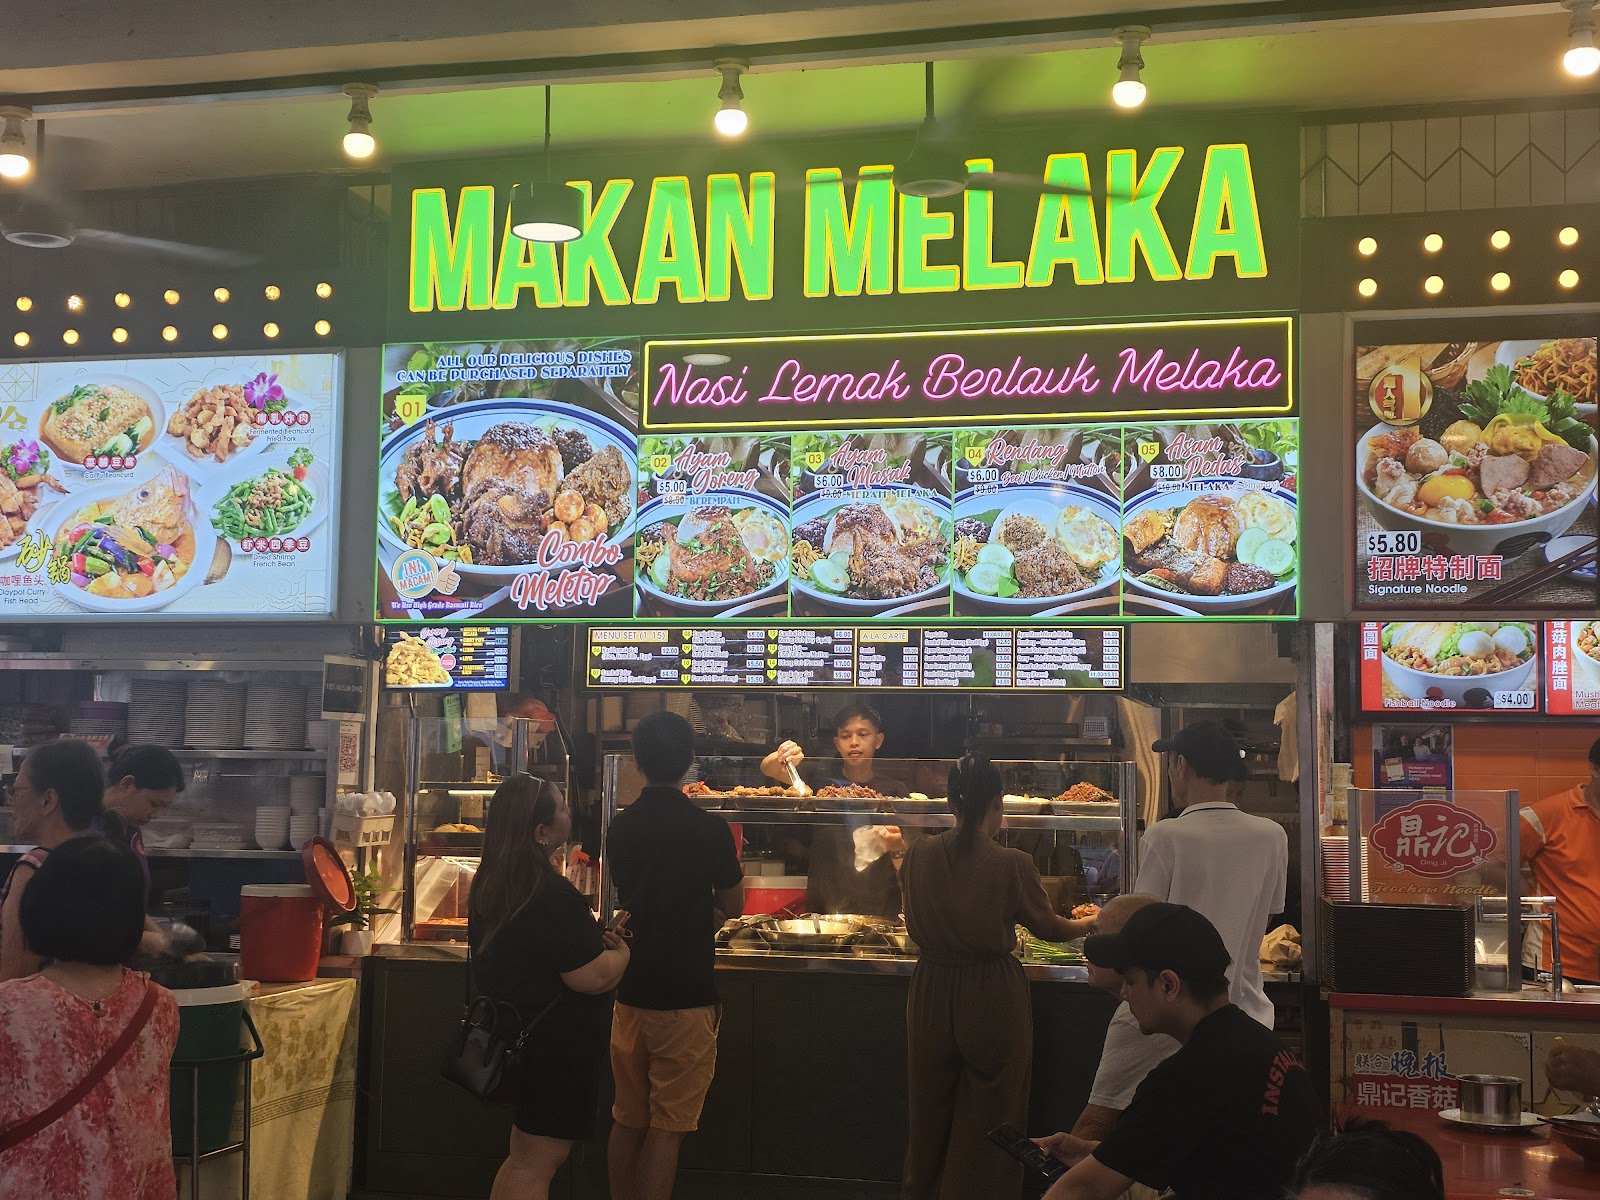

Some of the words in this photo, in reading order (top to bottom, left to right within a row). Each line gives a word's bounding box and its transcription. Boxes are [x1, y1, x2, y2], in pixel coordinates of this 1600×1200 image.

[409, 171, 776, 313] MAKAN
[803, 143, 1269, 298] MELAKA
[437, 355, 463, 368] ALL
[467, 354, 499, 367] OUR
[500, 352, 574, 366] DELICIOUS
[577, 350, 632, 364] DISHES
[396, 370, 426, 382] CAN
[428, 370, 447, 382] BE
[450, 367, 537, 382] PURCHASED
[540, 364, 631, 379] SEPARATELY
[651, 363, 748, 407] Nasi
[758, 358, 911, 404] Lemak
[922, 351, 1100, 400] Berlauk
[1112, 345, 1283, 394] Melaka
[401, 401, 421, 418] 01
[967, 448, 982, 460] 04
[986, 437, 1068, 466] Rendang
[1140, 444, 1156, 455] 05
[1164, 433, 1223, 462] Asam
[653, 456, 667, 468] 02
[673, 443, 732, 474] Ayam
[808, 453, 822, 465] 03
[830, 440, 886, 471] Ayam
[847, 458, 912, 491] Masak
[1152, 465, 1181, 478] $8.00
[1184, 452, 1245, 482] Pedas
[691, 467, 760, 495] Goreng
[816, 475, 842, 487] $6.00
[970, 469, 997, 481] $6.00
[658, 481, 685, 493] $5.00
[846, 490, 888, 499] MERAH
[889, 488, 938, 498] MELAKA
[1185, 482, 1230, 492] MELAKA
[689, 495, 741, 505] BEREMPAH
[538, 530, 623, 569] Combo
[1368, 532, 1418, 553] $5.80
[272, 553, 296, 561] Shrimp
[403, 559, 422, 575] INI
[1367, 555, 1503, 581] 招牌特制面
[399, 572, 435, 591] MACAM!
[511, 568, 616, 610] Meletop
[26, 588, 46, 597] Curry
[1368, 584, 1422, 595] Signature
[1425, 584, 1468, 594] Noodle
[4, 597, 17, 605] Fish
[19, 597, 39, 605] Head
[595, 631, 620, 640] MENU
[624, 631, 636, 640] SET
[1384, 698, 1419, 708] Fishball
[1421, 698, 1456, 708] Noodle
[1501, 693, 1529, 705] $4.00
[1396, 814, 1477, 858] 鼎记
[1420, 859, 1438, 867] Ding
[1369, 881, 1438, 895] Teochew
[1441, 882, 1498, 895] Noodle
[1357, 1081, 1458, 1110] 鼎记香菇
